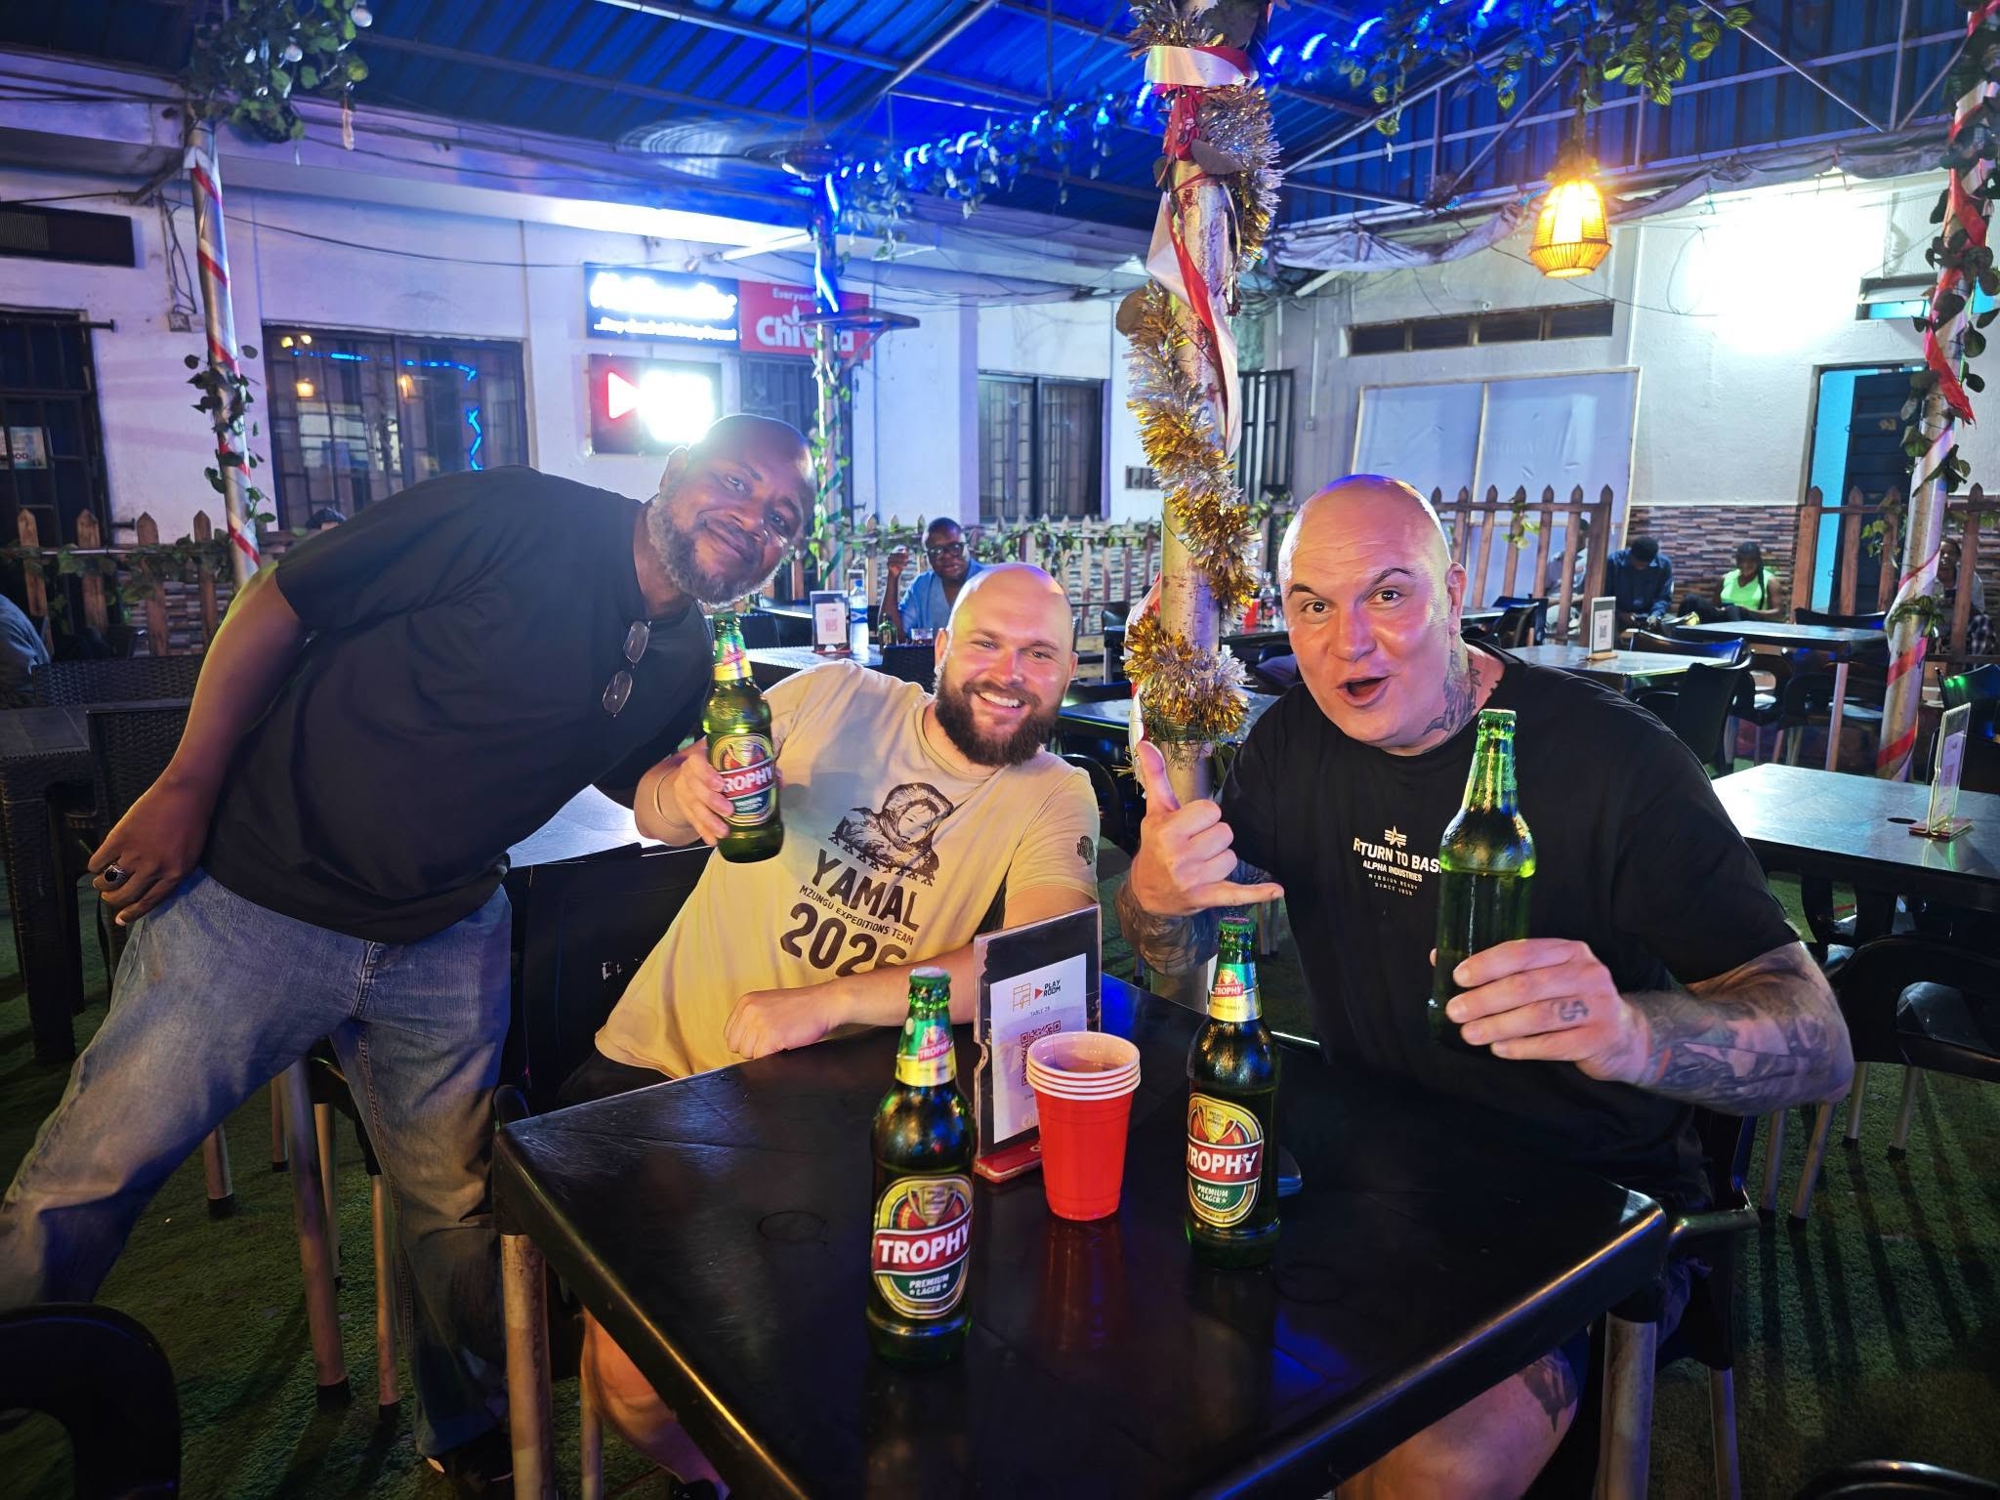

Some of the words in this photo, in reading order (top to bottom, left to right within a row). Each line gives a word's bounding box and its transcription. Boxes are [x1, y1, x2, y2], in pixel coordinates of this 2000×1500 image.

[1395, 851, 1408, 867] TO
[1411, 855, 1442, 873] BAS
[1363, 860, 1387, 872] ALPHA
[1388, 866, 1422, 882] INDUSTRIES
[811, 848, 920, 932] YAMAL
[799, 885, 834, 910] MZUNGU
[836, 907, 890, 934] EXPEDITIONS
[891, 928, 914, 945] TEAM
[1043, 986, 1062, 998] ROOM
[1044, 979, 1062, 990] PLAY
[1215, 984, 1243, 996] TROPHY
[1197, 1184, 1229, 1198] PREMIUM
[879, 1217, 971, 1265] TROPHY
[908, 1273, 950, 1290] PREMIUM
[916, 1284, 941, 1297] LAGER
